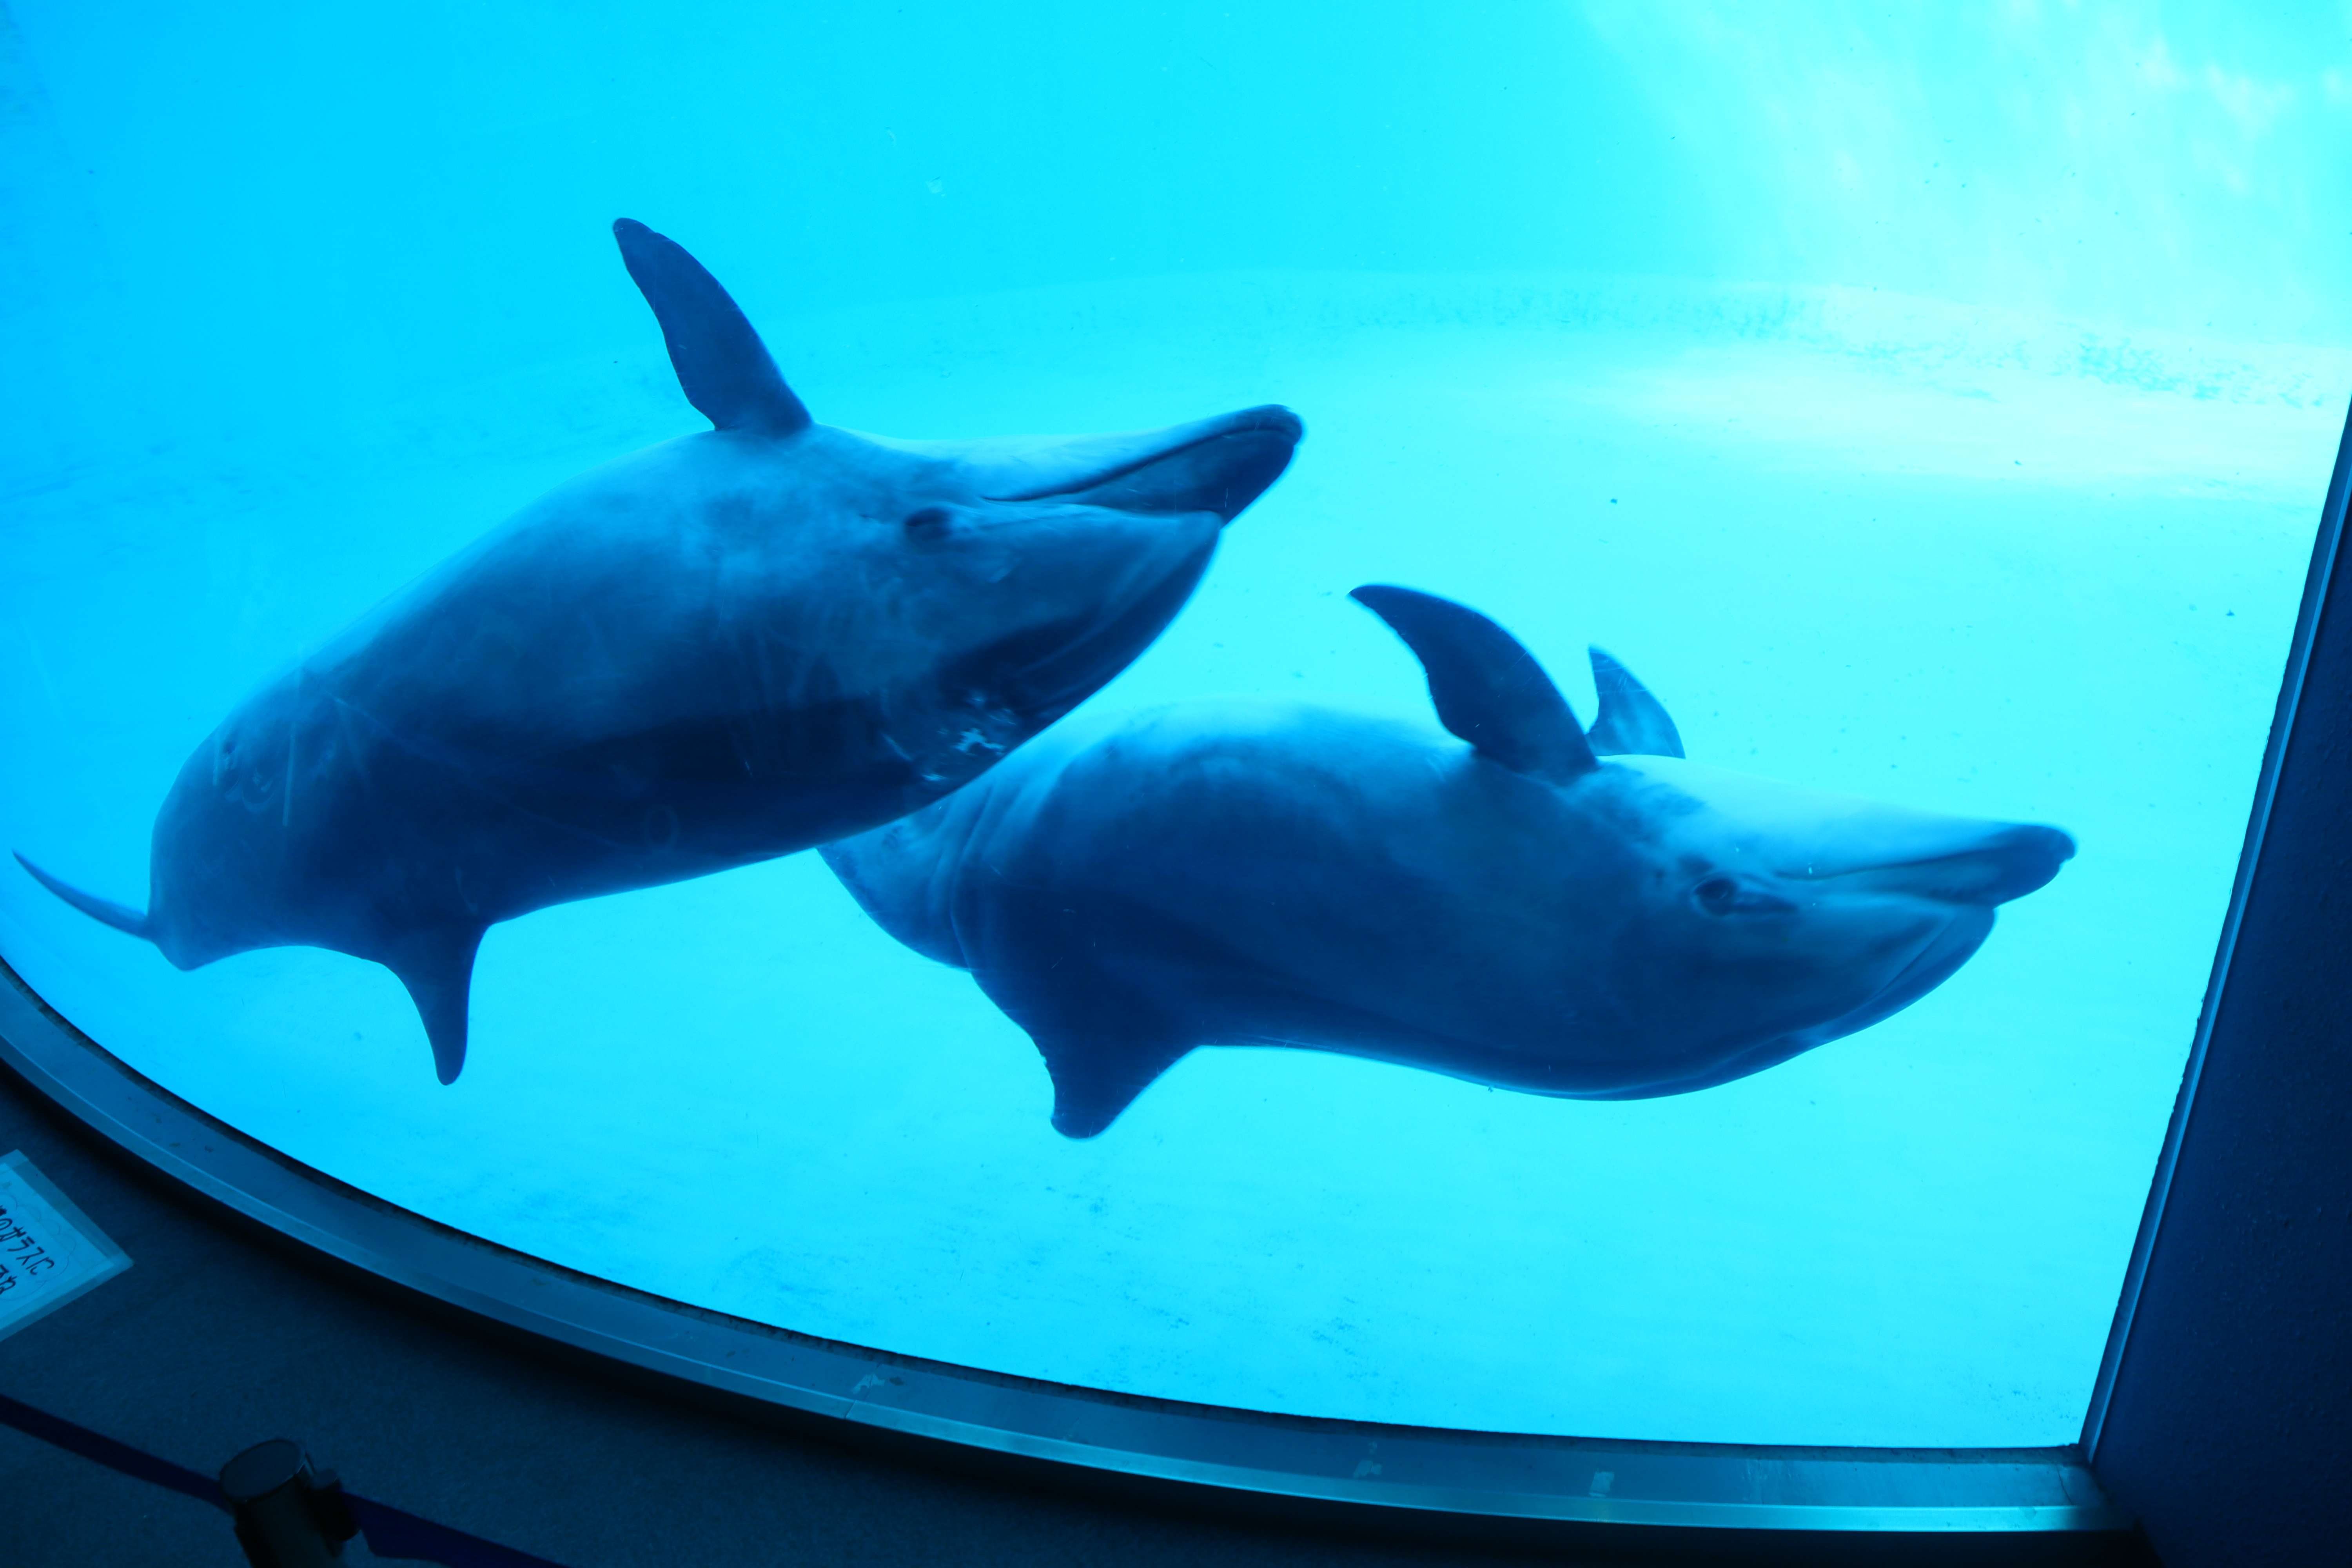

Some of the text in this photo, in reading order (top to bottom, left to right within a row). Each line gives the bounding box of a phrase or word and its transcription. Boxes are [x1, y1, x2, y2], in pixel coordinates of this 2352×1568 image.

[0, 1205, 54, 1275] のガラスに
